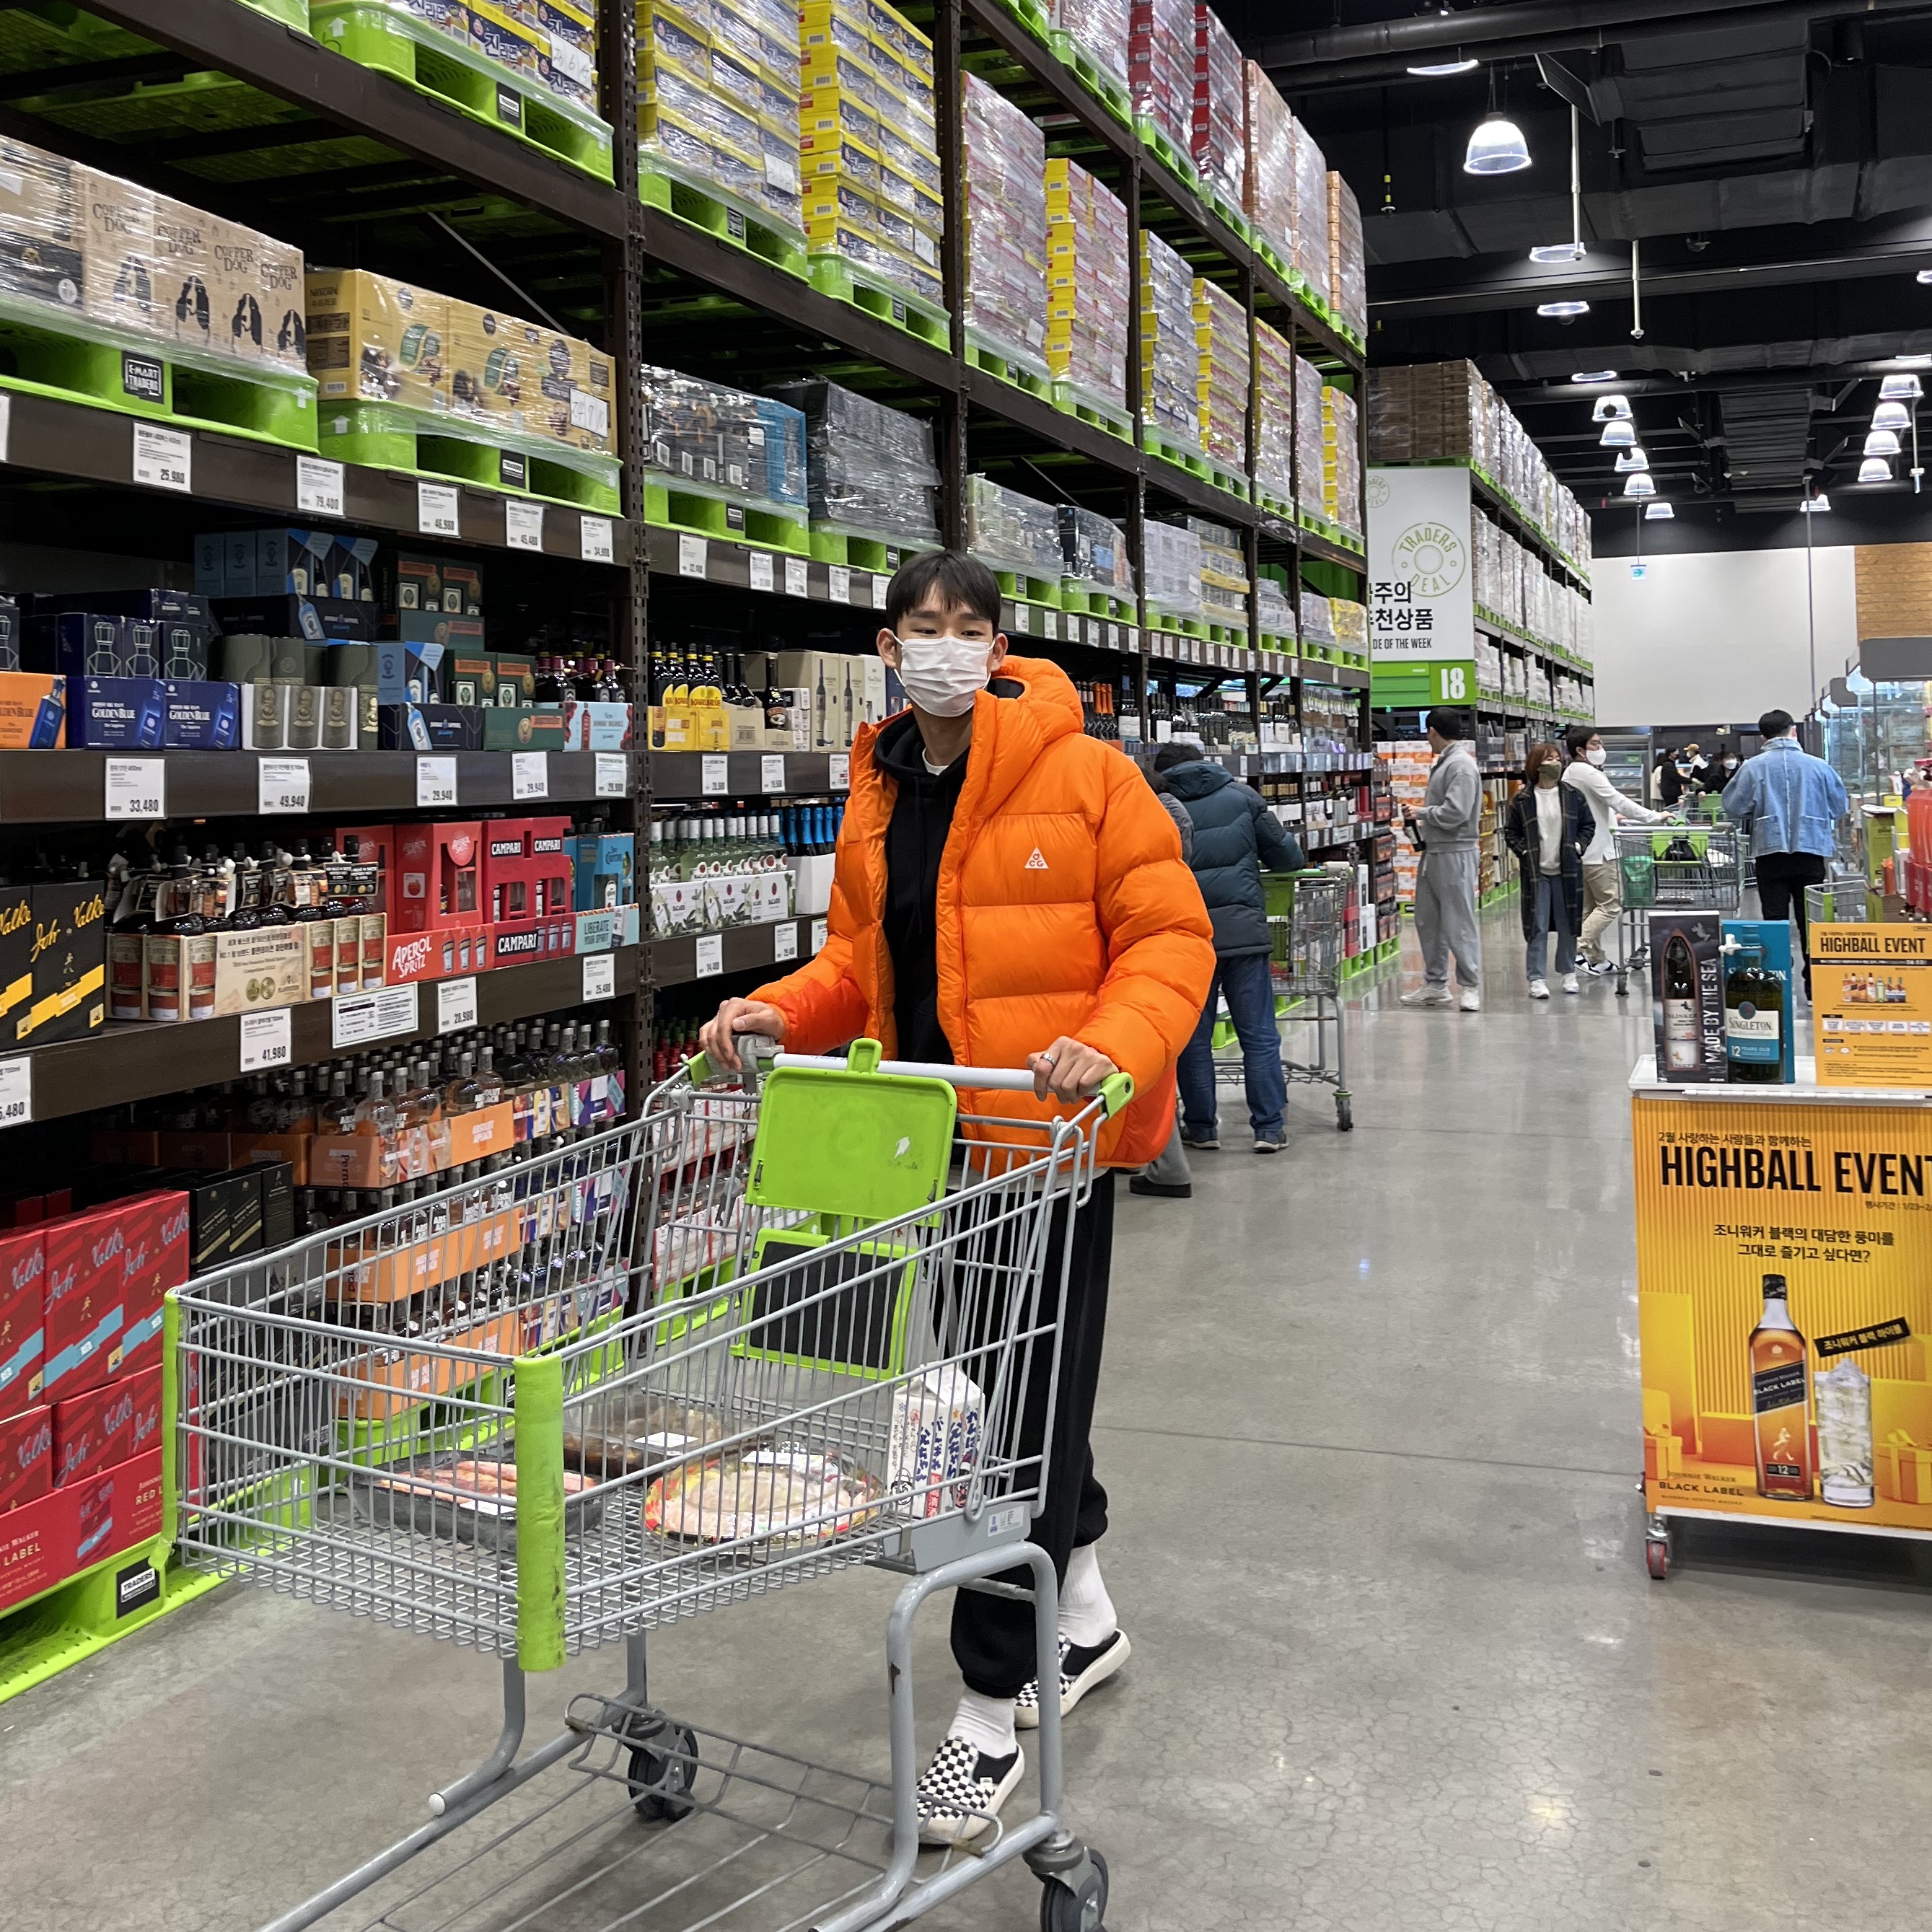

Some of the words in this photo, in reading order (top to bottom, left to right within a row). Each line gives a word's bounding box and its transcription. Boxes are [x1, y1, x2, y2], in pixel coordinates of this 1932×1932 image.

[167, 237, 195, 255] DOG
[214, 245, 255, 263] COPPER
[224, 256, 248, 274] DOG
[260, 263, 298, 281] COPPER
[269, 275, 292, 291] DOG
[1398, 527, 1458, 553] TRADERS
[1409, 573, 1452, 592] DEAL
[1369, 581, 1413, 605] 주의
[1384, 638, 1395, 649] OF
[1396, 638, 1410, 649] THE
[1411, 638, 1433, 649] WEEK
[1441, 667, 1466, 701] 18
[130, 799, 159, 814] 33,480
[491, 841, 522, 856] CAMPARI
[534, 838, 561, 852] CAMPARI
[498, 932, 538, 954] CAMPARI
[1820, 937, 1881, 953] HIGHBALL
[1884, 937, 1926, 954] EVENT
[392, 936, 432, 970] APEROL
[398, 954, 426, 978] SPRITZ
[1700, 957, 1718, 982] SEA
[1702, 983, 1719, 1008] THE
[1703, 1009, 1720, 1026] BY
[1703, 1028, 1721, 1063] MADE
[1731, 1045, 1742, 1058] 12
[1768, 1136, 1812, 1148] 함께하는
[1661, 1146, 1822, 1192] HIGHBALL
[1834, 1151, 1932, 1197] EVEN
[1713, 1224, 1765, 1239] 조니워커
[1768, 1226, 1808, 1242] 블랙의
[1812, 1229, 1851, 1244] 대담한
[1855, 1230, 1894, 1247] 풍미를
[1737, 1244, 1778, 1258] 그대로
[1780, 1245, 1820, 1261] 즐기고
[1822, 1248, 1871, 1264] 싶다면?
[1753, 1384, 1780, 1395] BLACK
[1780, 1377, 1806, 1388] LABEL
[1777, 1465, 1789, 1475] 12
[135, 1488, 157, 1506] RED
[1659, 1481, 1700, 1493] BLACK
[1703, 1485, 1744, 1497] LABEL
[3, 1542, 42, 1567] LABEL
[123, 1570, 154, 1591] TRADERS
